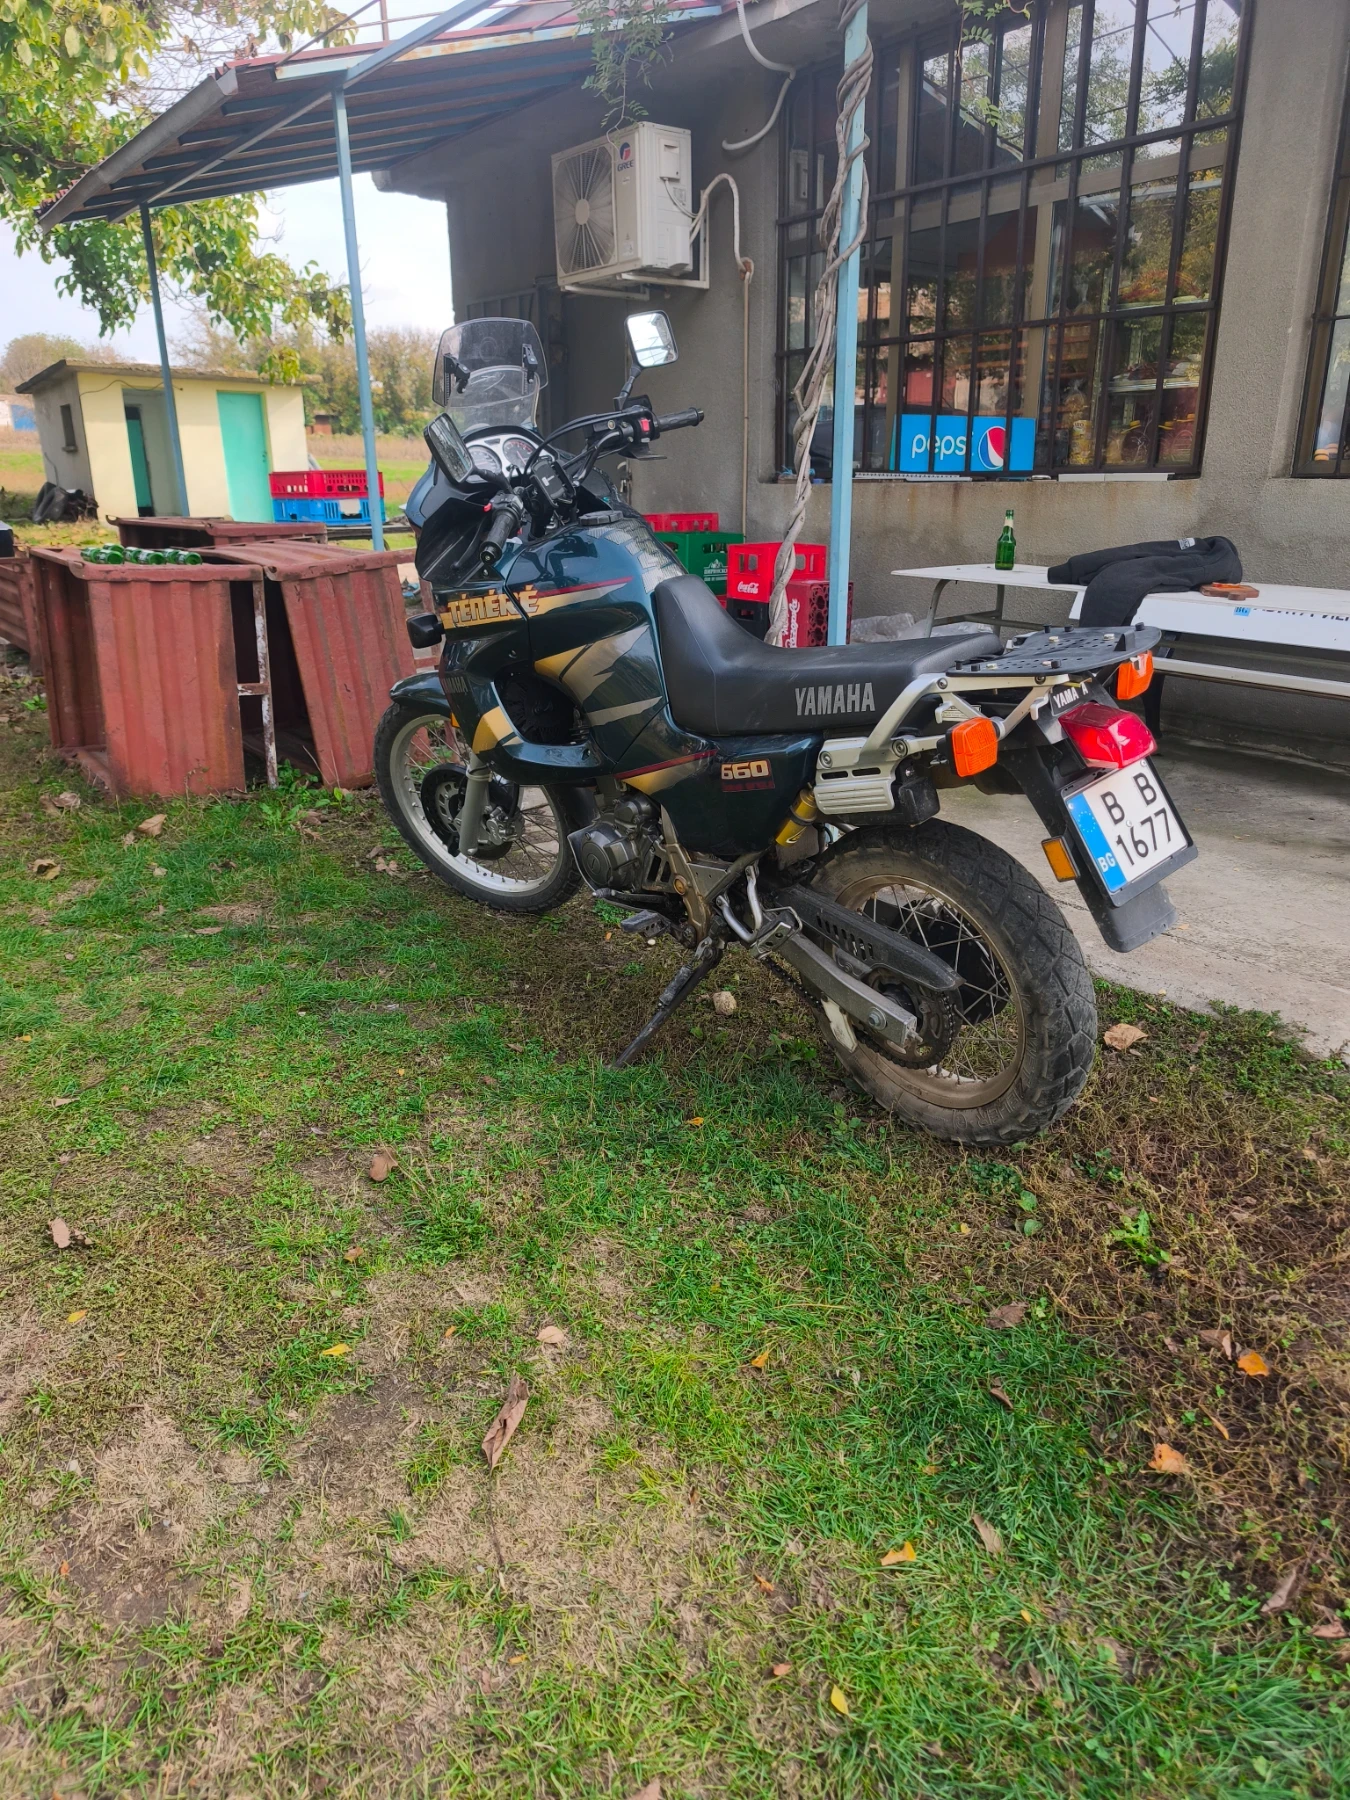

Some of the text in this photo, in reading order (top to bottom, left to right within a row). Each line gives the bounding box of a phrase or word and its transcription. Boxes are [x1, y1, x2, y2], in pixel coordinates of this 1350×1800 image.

[617, 160, 634, 171] GREE
[912, 434, 974, 460] peps
[795, 683, 875, 716] YAMAHA
[1053, 681, 1089, 708] YAMAA
[721, 760, 769, 780] 660
[1100, 772, 1157, 825] B B
[1116, 807, 1171, 866] 1677
[1097, 852, 1116, 873] BG
